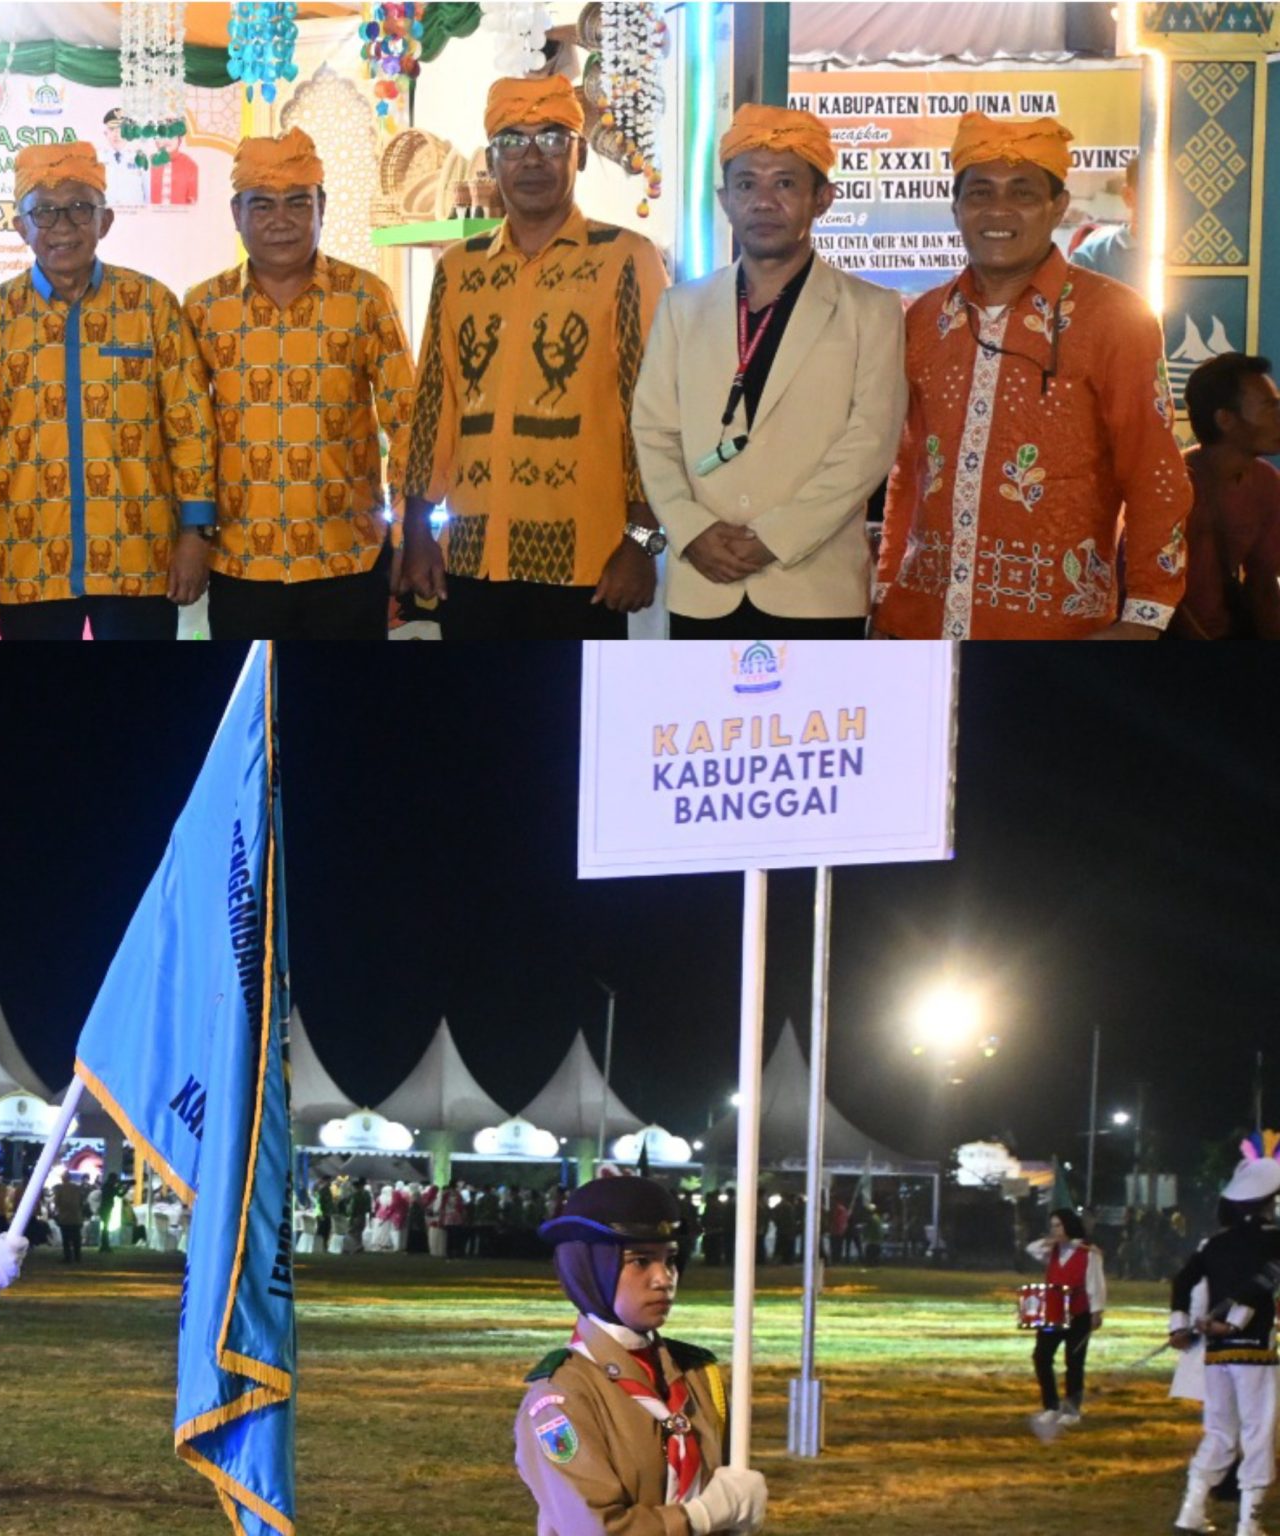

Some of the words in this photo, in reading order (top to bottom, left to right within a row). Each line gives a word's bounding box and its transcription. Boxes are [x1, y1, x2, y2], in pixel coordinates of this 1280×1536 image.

[818, 96, 919, 115] KABUPATEN
[927, 95, 968, 114] TOJO
[976, 95, 1011, 113] UNA
[1020, 95, 1056, 113] UNA
[829, 126, 889, 146] ucapkan
[840, 152, 868, 171] KE
[879, 152, 931, 171] XXXI
[834, 181, 871, 200] SIGI
[881, 181, 950, 200] TAHUN
[837, 236, 869, 250] CINTA
[922, 235, 943, 249] DAN
[869, 254, 916, 268] SULTENG
[651, 707, 867, 756] KAFILAH
[652, 747, 864, 791] KABUPATEN
[673, 785, 838, 824] BANGGAI
